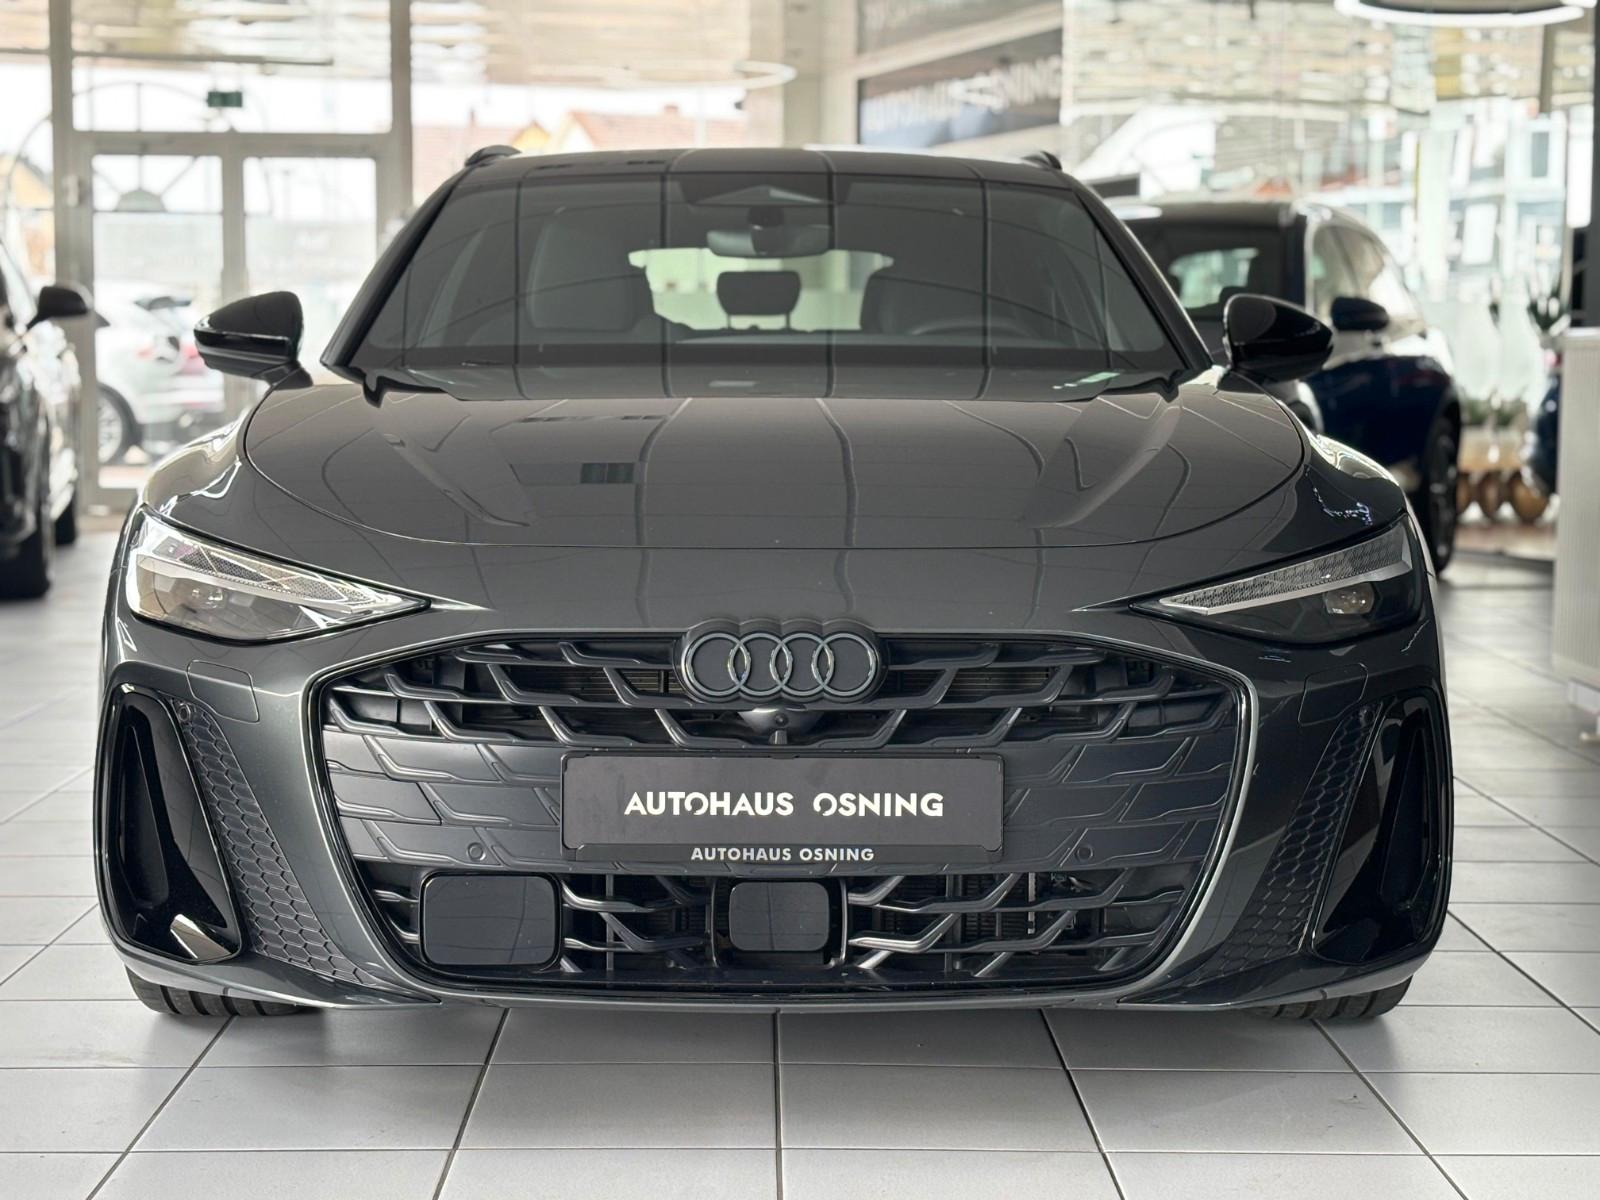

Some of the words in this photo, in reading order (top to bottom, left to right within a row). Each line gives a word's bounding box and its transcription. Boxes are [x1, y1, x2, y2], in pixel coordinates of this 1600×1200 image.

[623, 791, 794, 817] AUTOHAUS
[812, 791, 943, 817] OSNING
[690, 847, 791, 862] AUTOHAUS
[799, 847, 874, 862] OSNING
